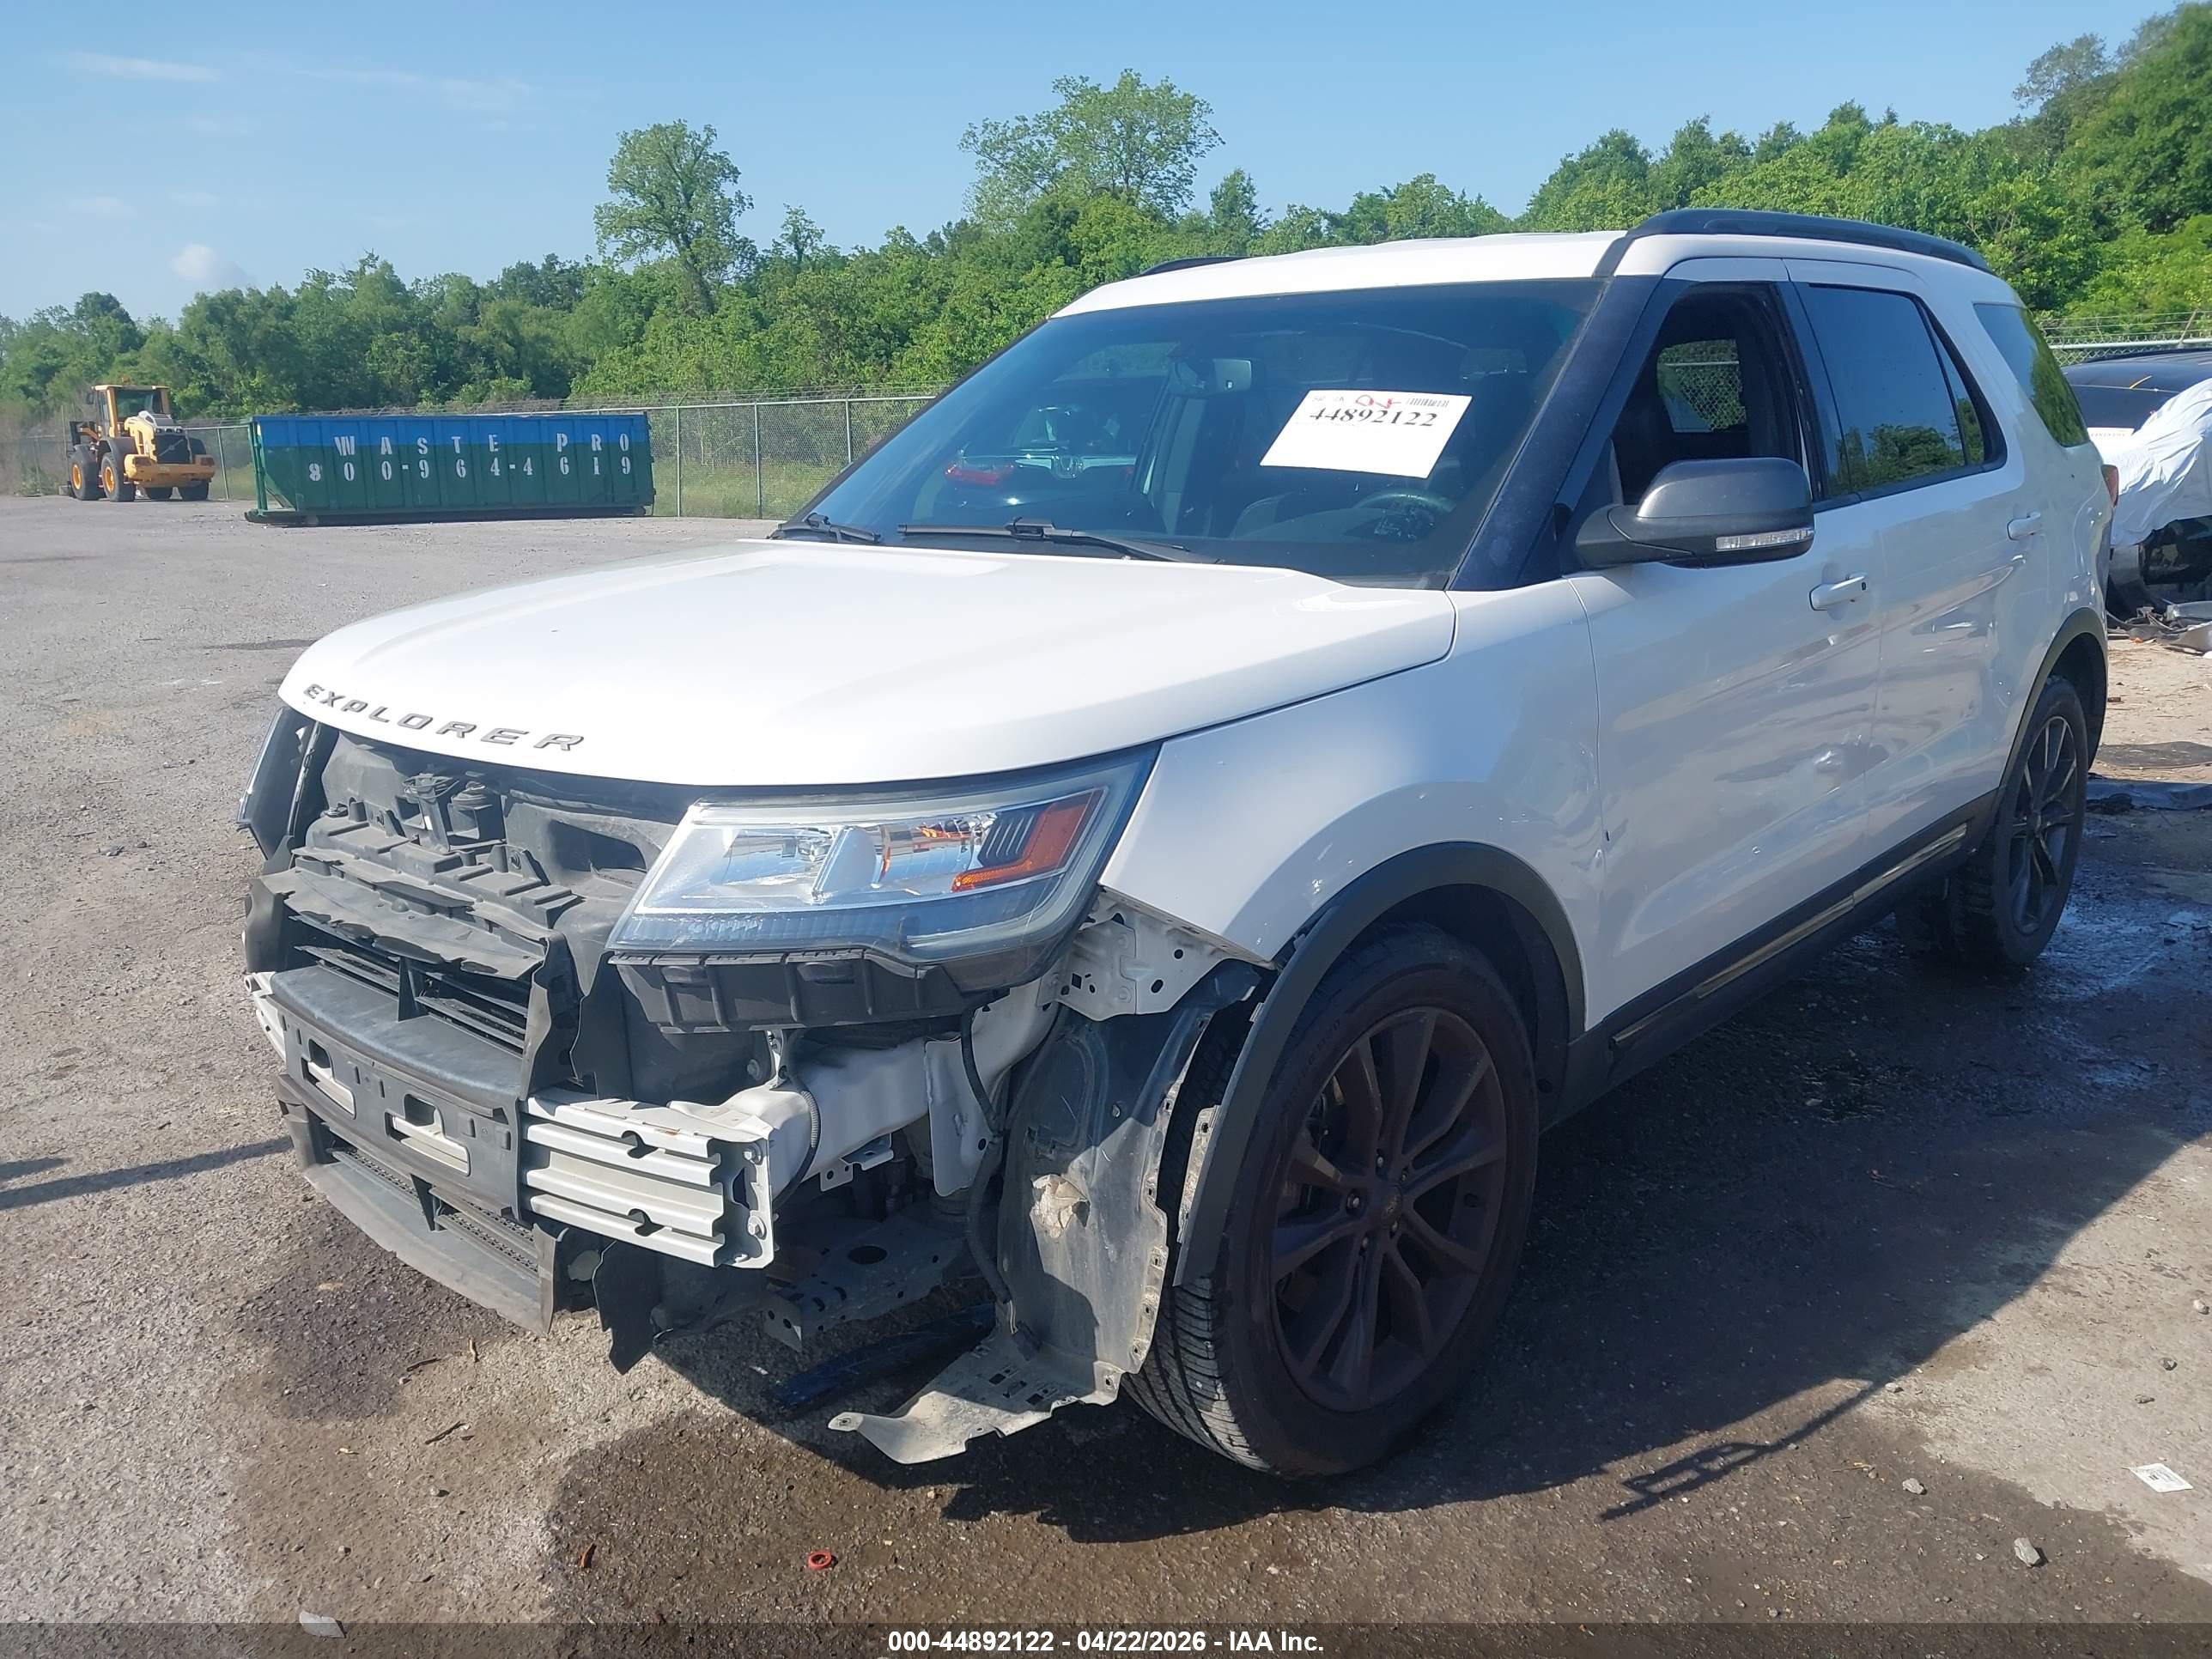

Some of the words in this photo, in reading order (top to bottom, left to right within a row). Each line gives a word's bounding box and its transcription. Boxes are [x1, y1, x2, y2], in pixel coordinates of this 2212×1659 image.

[1310, 407, 1438, 427] 44892122
[334, 433, 500, 456] WASTE
[556, 432, 630, 453] PRO
[303, 684, 585, 752] EXPLORER
